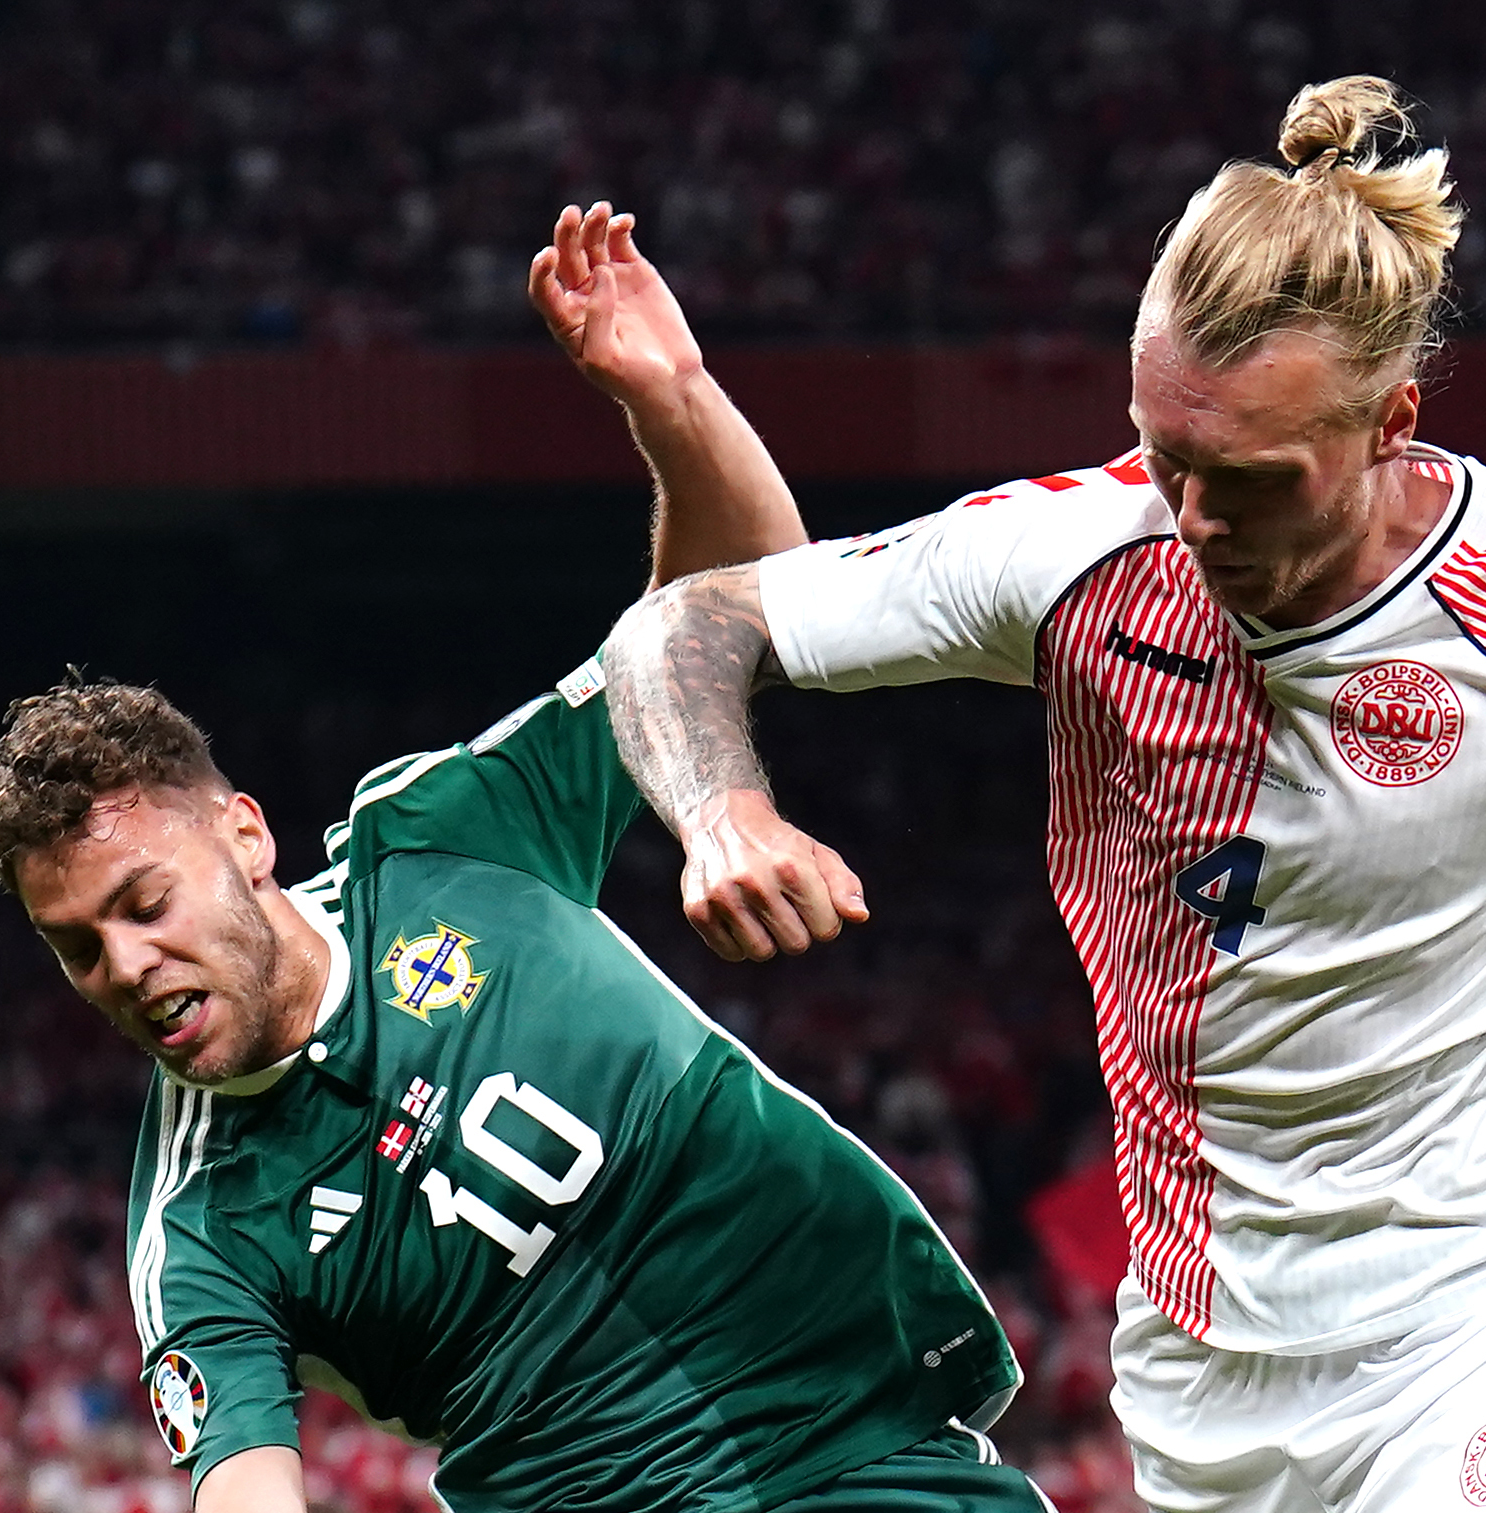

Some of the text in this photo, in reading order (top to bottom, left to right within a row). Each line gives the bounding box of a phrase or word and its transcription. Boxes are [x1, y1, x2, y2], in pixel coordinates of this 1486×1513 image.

[1106, 620, 1217, 687] hummel
[1336, 690, 1363, 762] DANSK
[1358, 702, 1437, 743] DBU
[1365, 762, 1417, 781] 1889
[1175, 833, 1268, 960] 4
[418, 1071, 605, 1279] 10
